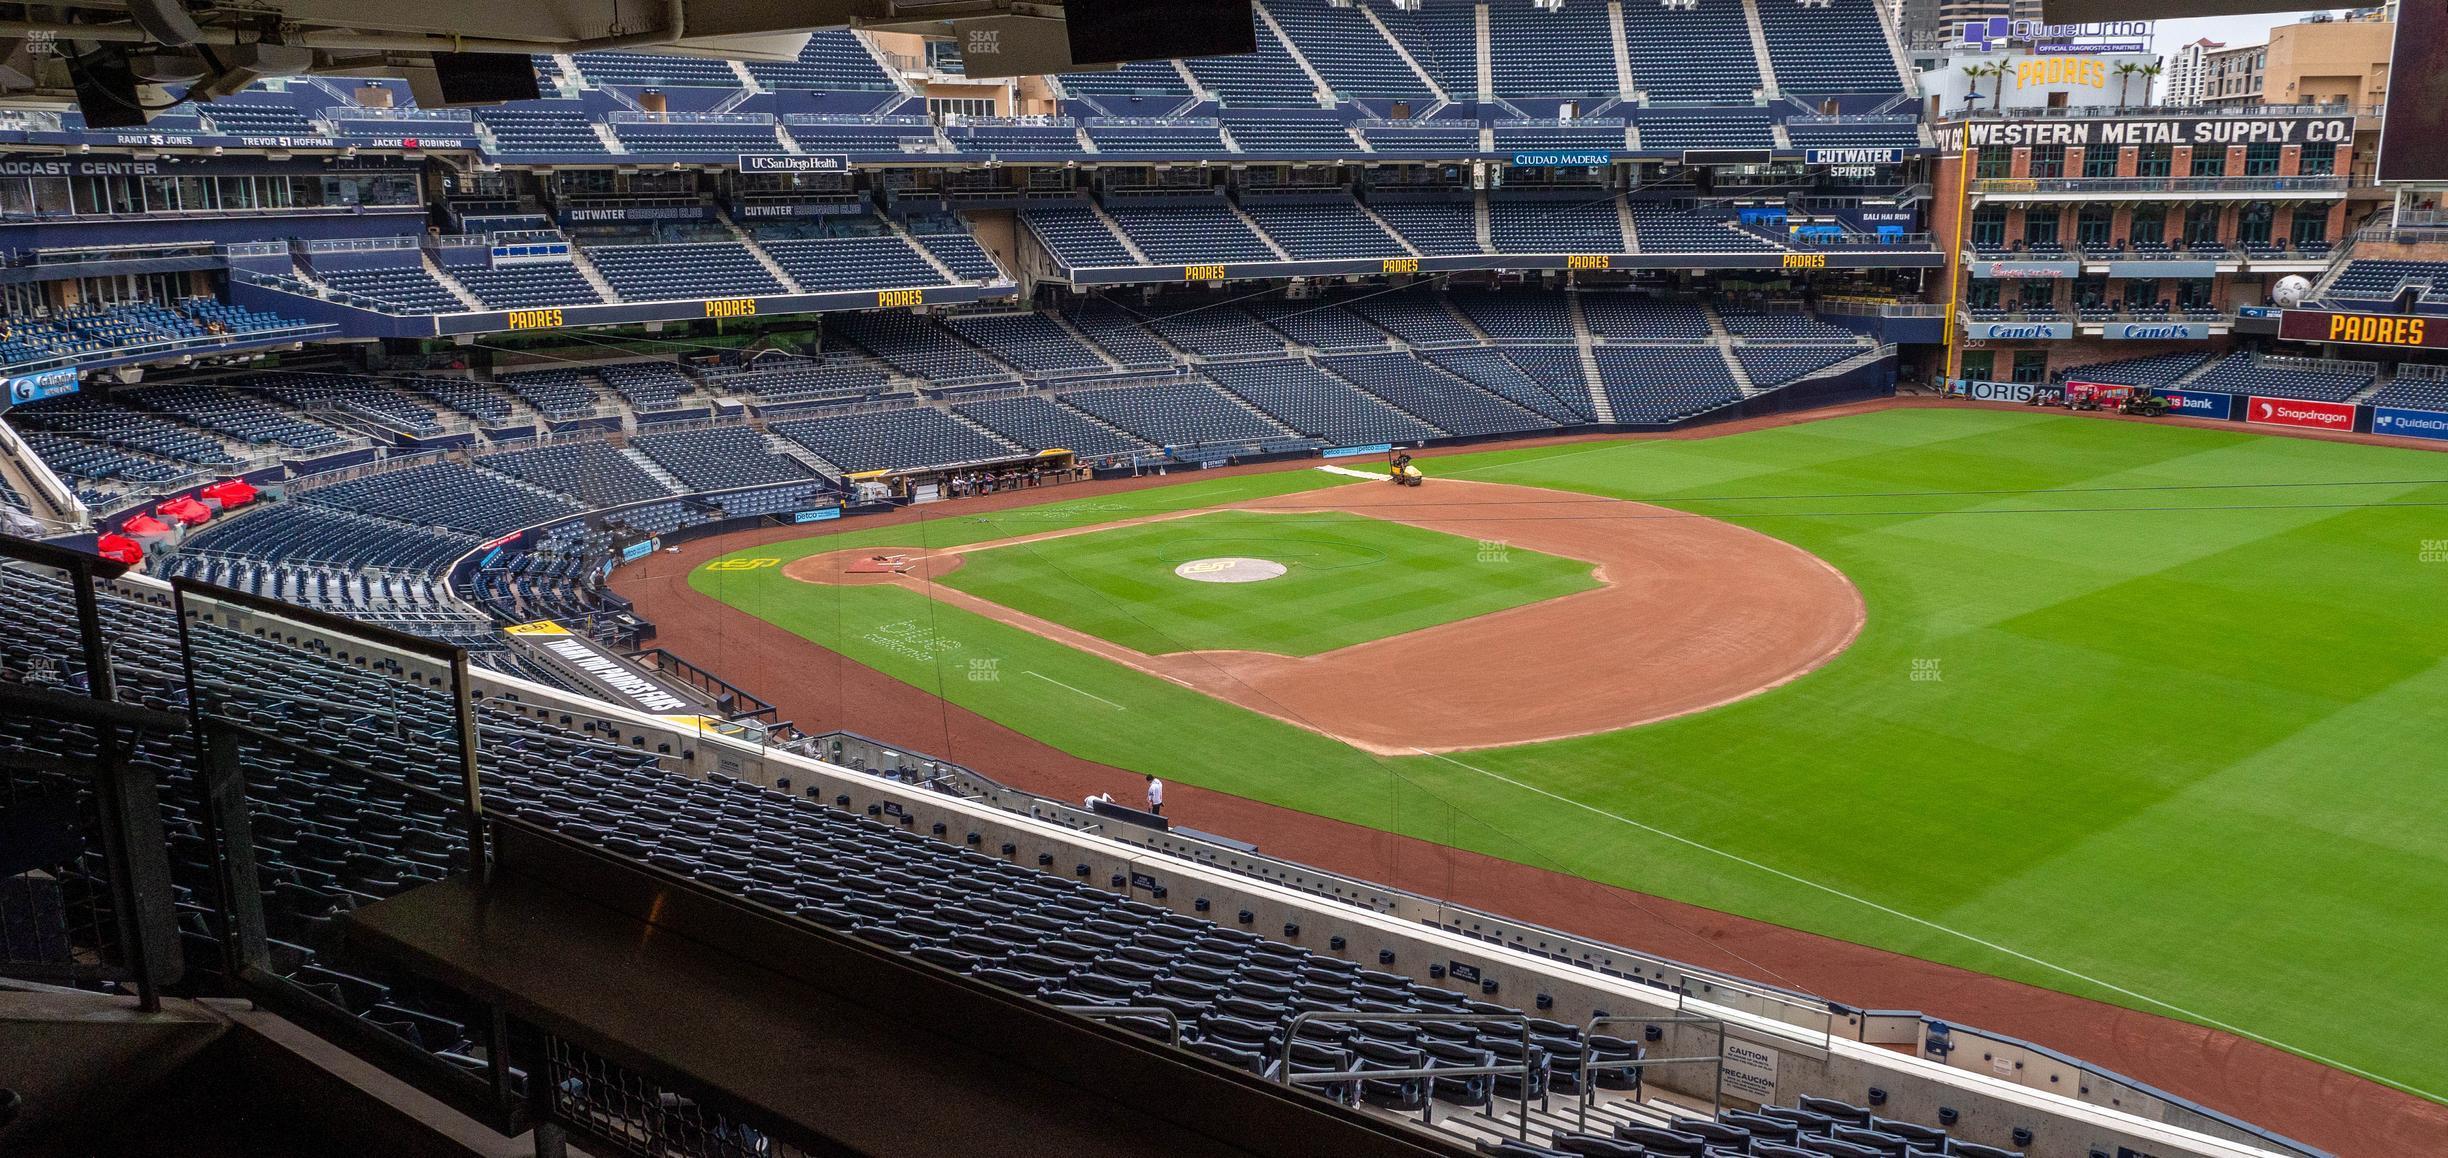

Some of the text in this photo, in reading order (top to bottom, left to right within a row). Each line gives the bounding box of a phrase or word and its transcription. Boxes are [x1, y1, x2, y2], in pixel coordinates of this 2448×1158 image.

[2017, 57, 2105, 89] PADRES
[118, 134, 193, 145] RANDY 35 JONES
[1969, 120, 2350, 145] WESTERN METAL SUPPLY CO.
[242, 137, 333, 146] TREVOR 51 HOFFMAN
[372, 138, 462, 147] JACKIE 42 ROBINSON
[752, 157, 838, 170] UC San Diego Health
[1516, 155, 1608, 165] CIUDAD MADERAS
[1817, 150, 1892, 163] CUTWATER
[80, 162, 158, 175] CENTER
[1830, 166, 1876, 177] SPIRITS
[571, 209, 625, 220] CUTWATER
[745, 206, 792, 216] CUTWATER
[1863, 213, 1879, 221] BALI
[1383, 259, 1419, 273] PADRES
[1568, 255, 1609, 268] PADRES
[1783, 254, 1825, 268] PADRES
[1185, 265, 1225, 280] PADRES
[879, 290, 922, 307] PADRES
[705, 299, 756, 317] PADRES
[509, 309, 563, 329] PADRES
[1988, 323, 2053, 339] Canel's
[2124, 323, 2189, 339] Canel's
[2329, 314, 2424, 345] PADRES
[40, 372, 77, 387] Gallaghe
[1975, 383, 2032, 401] ORIS
[2183, 396, 2214, 409] bank
[2277, 406, 2347, 424] Snapdragon
[1358, 444, 1375, 452] petco
[796, 512, 818, 521] petco
[543, 638, 599, 660] THANK
[591, 667, 658, 694] PADRES
[631, 690, 686, 711] FANS
[1729, 1046, 1768, 1062] CAUTION
[1720, 1067, 1775, 1088] PRECAUCIÓN
